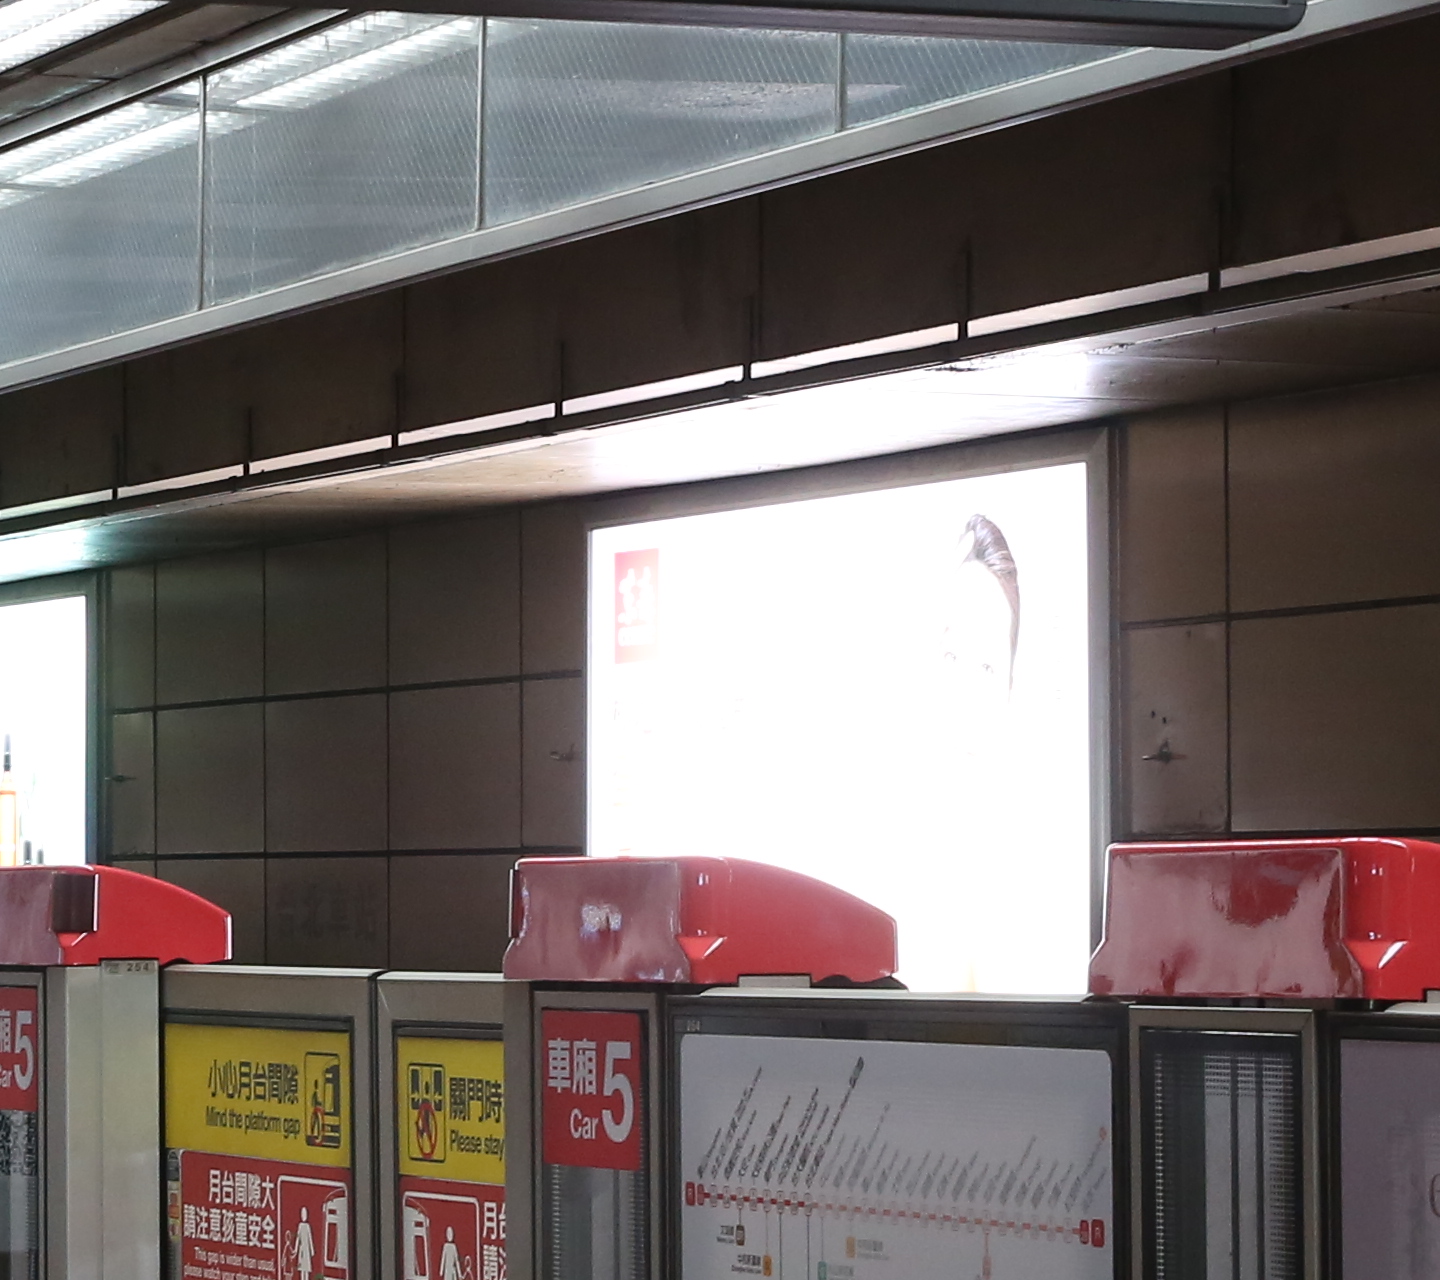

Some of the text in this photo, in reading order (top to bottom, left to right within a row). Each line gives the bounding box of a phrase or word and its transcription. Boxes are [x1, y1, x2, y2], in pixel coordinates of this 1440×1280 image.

[13, 1011, 35, 1092] 5
[207, 1059, 299, 1105] 小心月台間隙
[547, 1036, 598, 1095] 車廂
[601, 1041, 635, 1144] 5
[206, 1105, 301, 1140] Mind the platform gap
[568, 1107, 600, 1141] Car
[449, 1129, 504, 1162] Please stay
[209, 1168, 275, 1211] 月台間隙大
[183, 1204, 276, 1250] 請注意孩童安全
